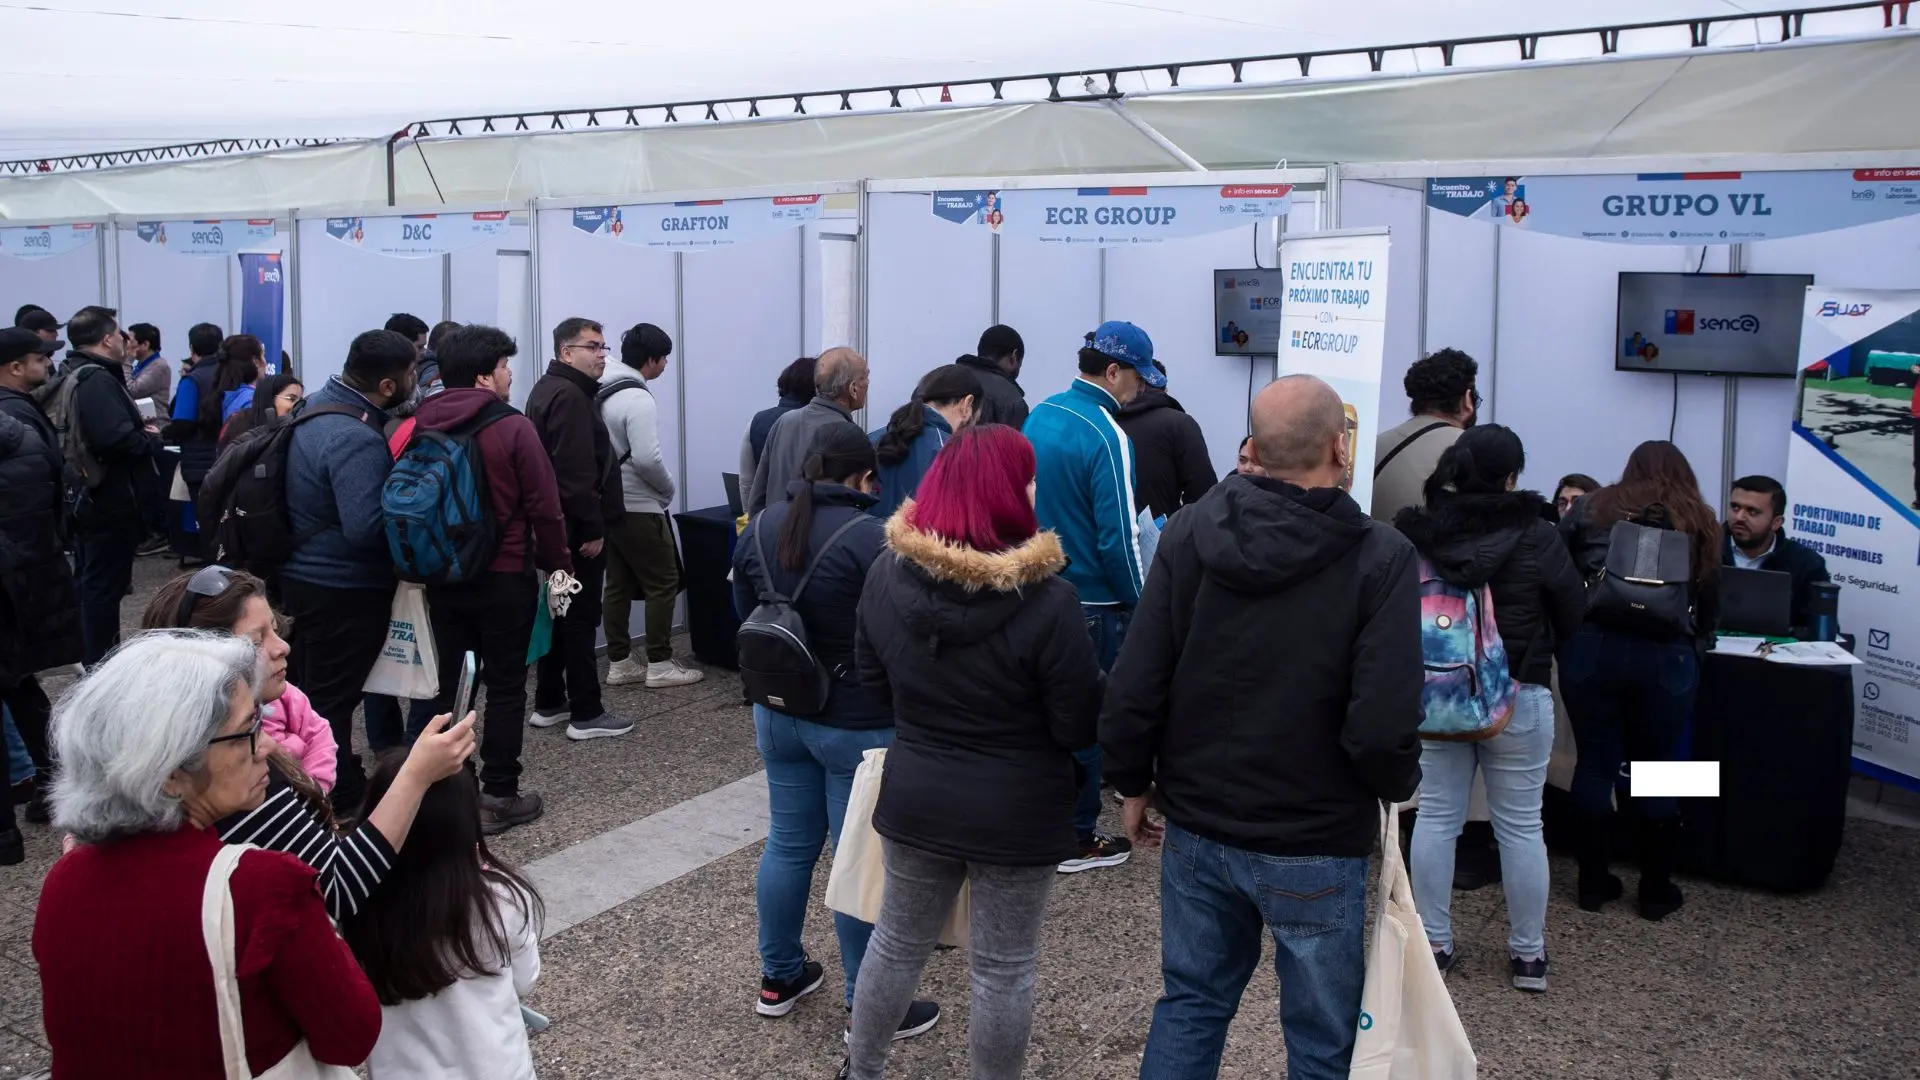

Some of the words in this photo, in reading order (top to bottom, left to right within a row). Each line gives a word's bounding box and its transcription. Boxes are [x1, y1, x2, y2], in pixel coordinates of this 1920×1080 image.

[1873, 169, 1891, 177] info
[1233, 187, 1245, 195] info
[1254, 187, 1279, 195] sence.cl
[1431, 183, 1471, 191] Encuentro
[1446, 190, 1485, 198] TRABAJO
[1602, 194, 1719, 216] GRUPO
[1727, 193, 1772, 216] VL
[661, 216, 730, 232] GRAFTON
[1045, 206, 1089, 225] ECR
[1094, 206, 1177, 226] GROUP
[402, 224, 432, 241] D&C
[1290, 261, 1355, 281] ENCUENTRA
[1358, 261, 1373, 280] TU
[1288, 284, 1329, 304] PRÓXIMO
[1331, 288, 1370, 310] TRABAJO
[1320, 311, 1334, 323] CON
[1302, 331, 1358, 353] ECRGROUP
[1793, 503, 1865, 528] OPORTUNIDAD
[1867, 516, 1882, 530] DE
[1792, 517, 1836, 538] TRABAJO
[1825, 543, 1884, 566] DISPONIBLES
[1833, 572, 1846, 583] de
[1848, 575, 1900, 595] Seguridad.
[1904, 660, 1915, 668] CV
